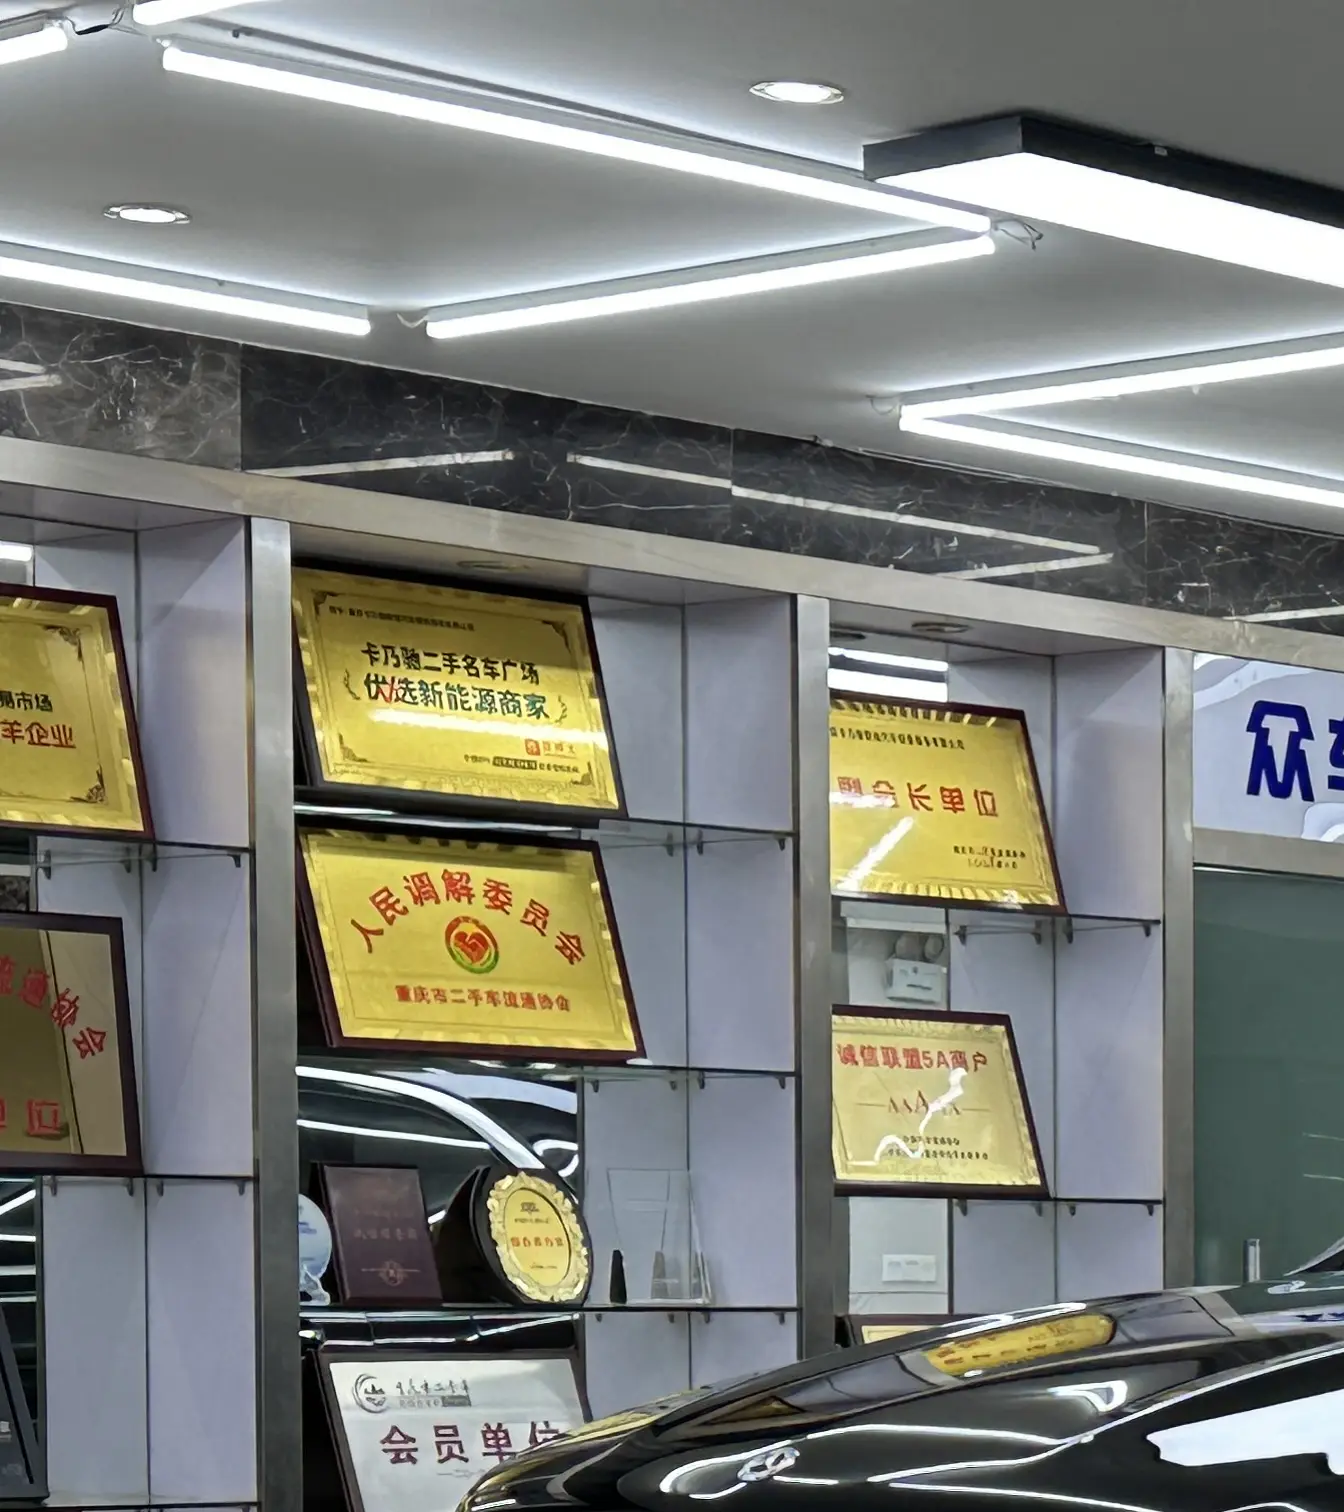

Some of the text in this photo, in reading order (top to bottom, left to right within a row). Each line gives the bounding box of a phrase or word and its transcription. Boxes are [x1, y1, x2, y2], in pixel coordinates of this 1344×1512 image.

[363, 672, 551, 721] 优选新能源商家
[350, 868, 586, 966] 人民调解委员会
[380, 1420, 560, 1466] 会员单位
